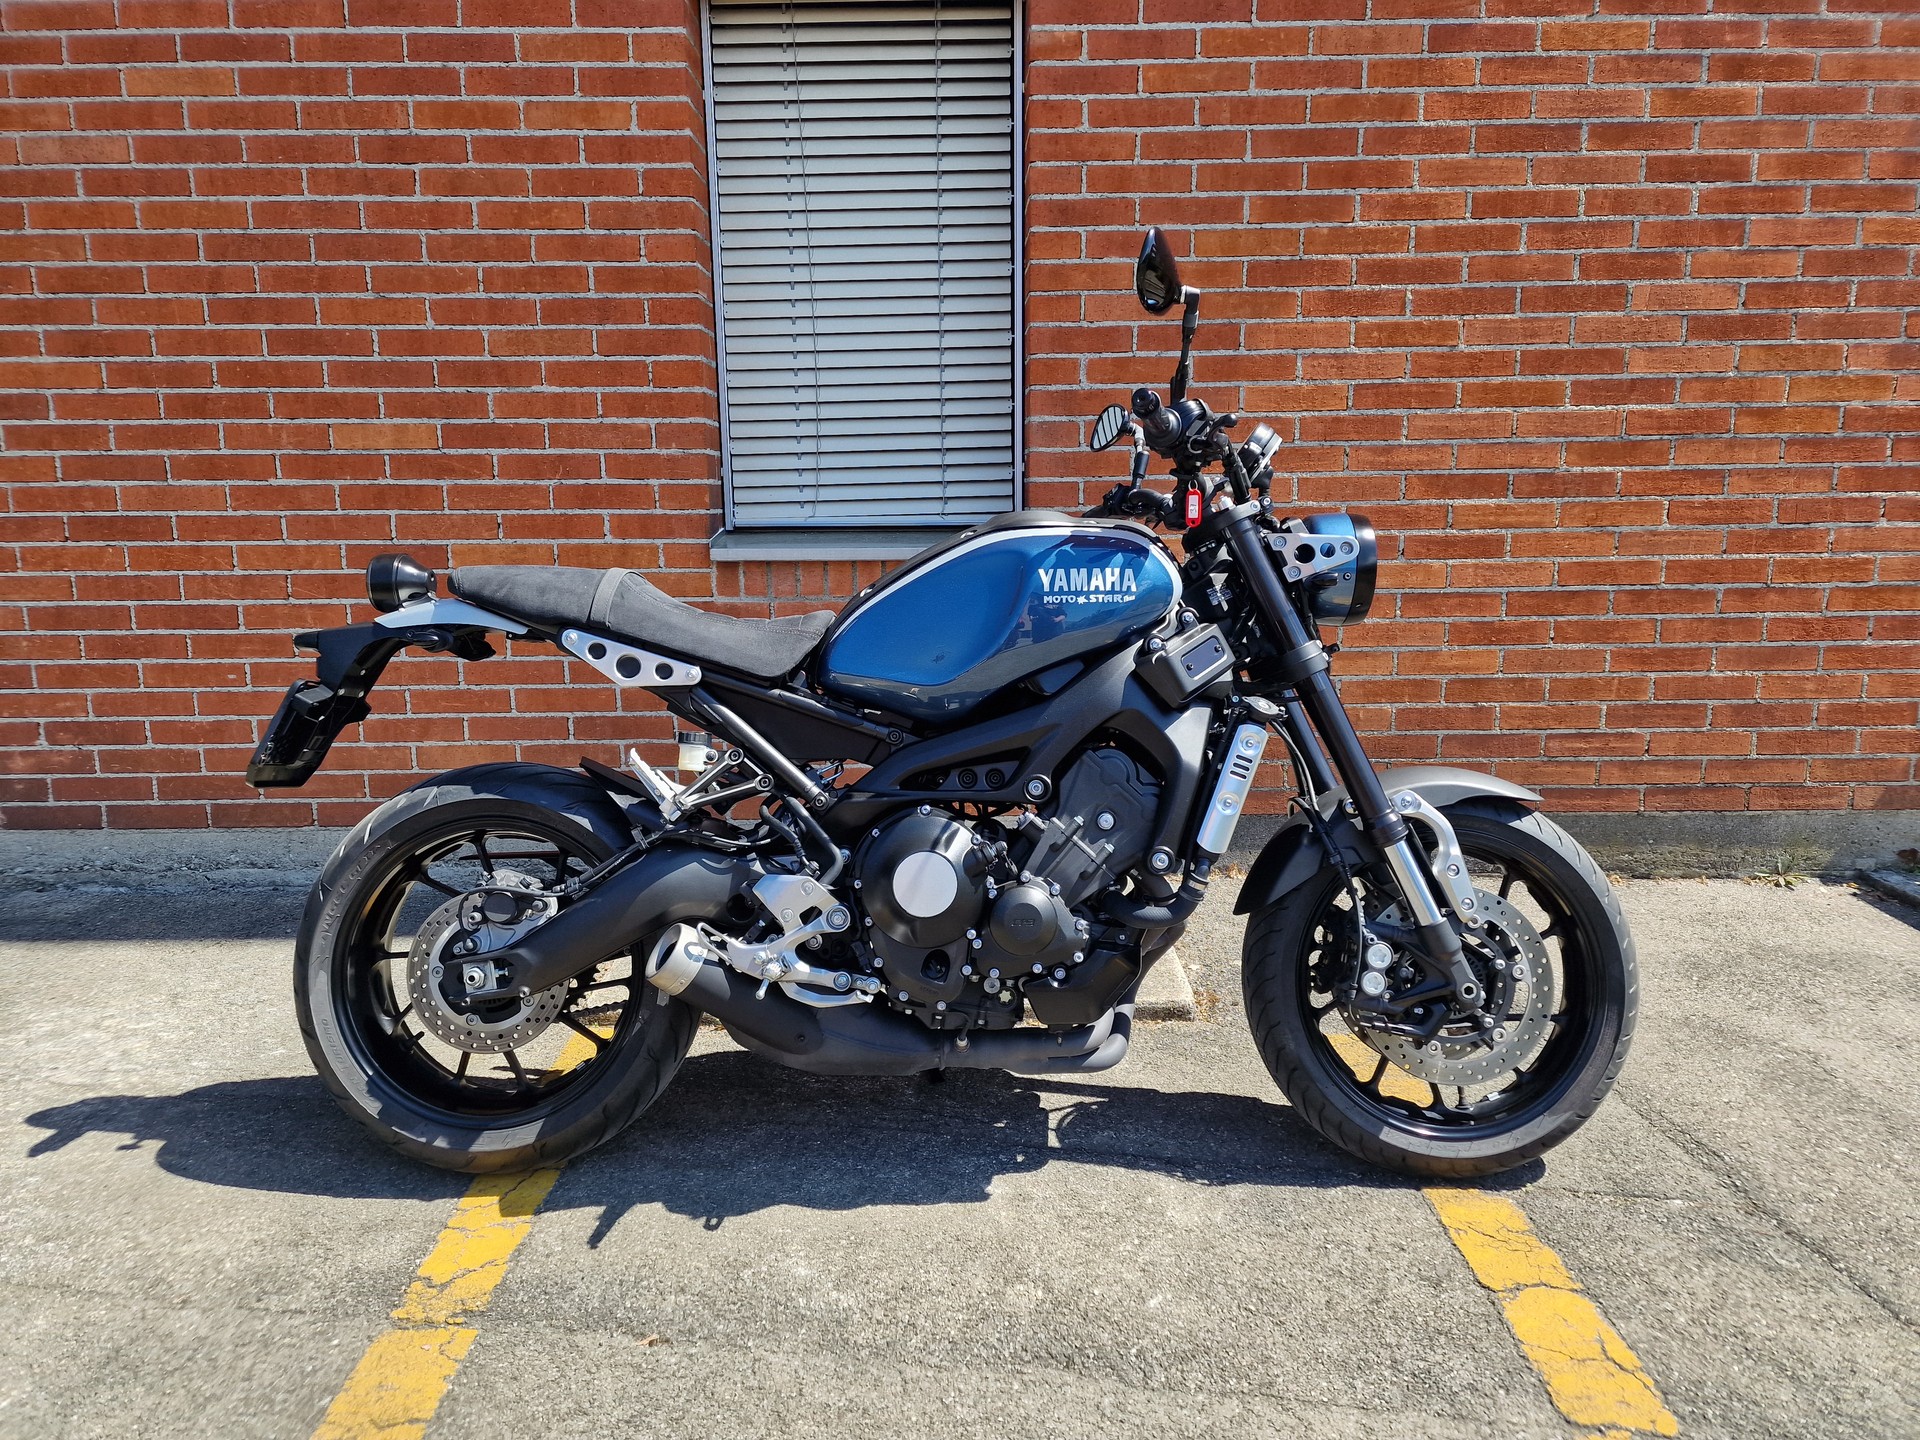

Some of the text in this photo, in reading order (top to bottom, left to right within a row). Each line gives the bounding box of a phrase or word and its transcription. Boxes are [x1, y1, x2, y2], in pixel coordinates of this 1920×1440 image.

[1038, 568, 1137, 592] YAMAHA
[1043, 595, 1076, 604] MOTO
[1089, 594, 1123, 603] STAR
